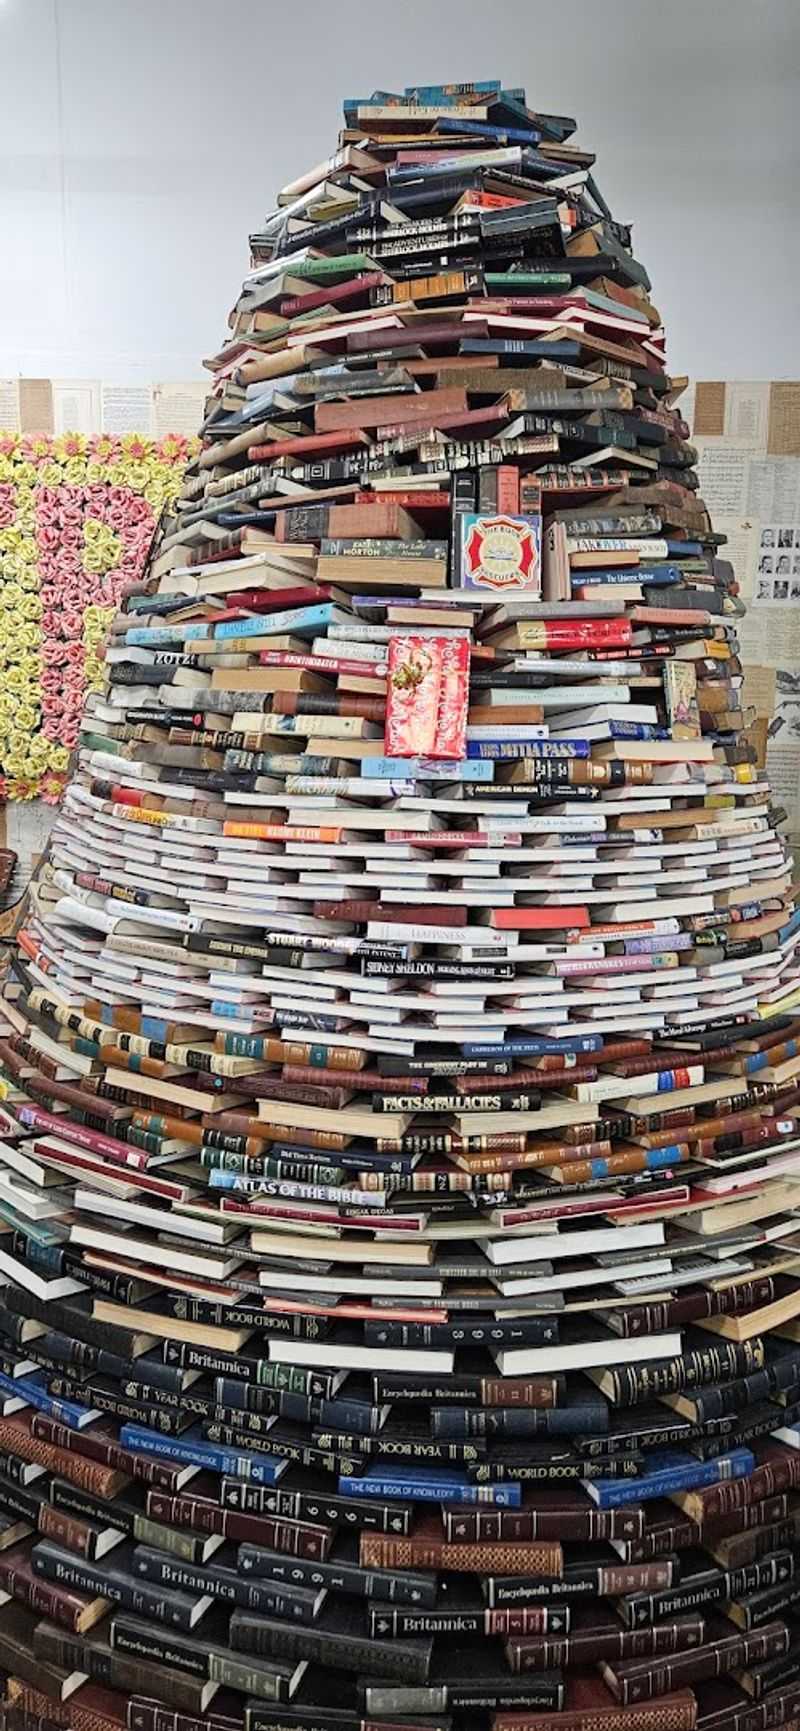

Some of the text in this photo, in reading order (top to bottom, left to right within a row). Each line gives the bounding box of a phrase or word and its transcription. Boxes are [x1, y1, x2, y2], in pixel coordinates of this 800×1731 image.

[343, 548, 380, 556] MORTON
[153, 653, 196, 665] ZOTZ!
[542, 742, 576, 758] PASS
[475, 785, 512, 793] AMERICAN
[267, 933, 307, 948] STUART
[367, 962, 394, 973] SIDNEY
[396, 962, 436, 975] SHELDON
[233, 1180, 371, 1204] ATLAS OF THE BIBLE
[346, 1208, 395, 1216] EDGAR DEGAS
[225, 1311, 291, 1330] WORLD BOOK
[189, 1351, 250, 1377] Britannica
[155, 1391, 209, 1416] YEAR BOOK
[117, 1402, 148, 1422] WORLD
[128, 1436, 139, 1447] THE
[156, 1443, 171, 1456] BOOK
[236, 1433, 301, 1460] WORLD BOOK
[378, 1442, 442, 1457] YEAR BOOK
[507, 1466, 580, 1479] WORLD BOOK
[351, 1483, 454, 1498] THE NEW BOOK OF KNOWLEDGE
[56, 1563, 122, 1601] Britannica
[161, 1564, 236, 1600] Britannica
[551, 1580, 594, 1594] Britannica
[659, 1588, 721, 1615] Britannica
[403, 1616, 478, 1632] Britannica
